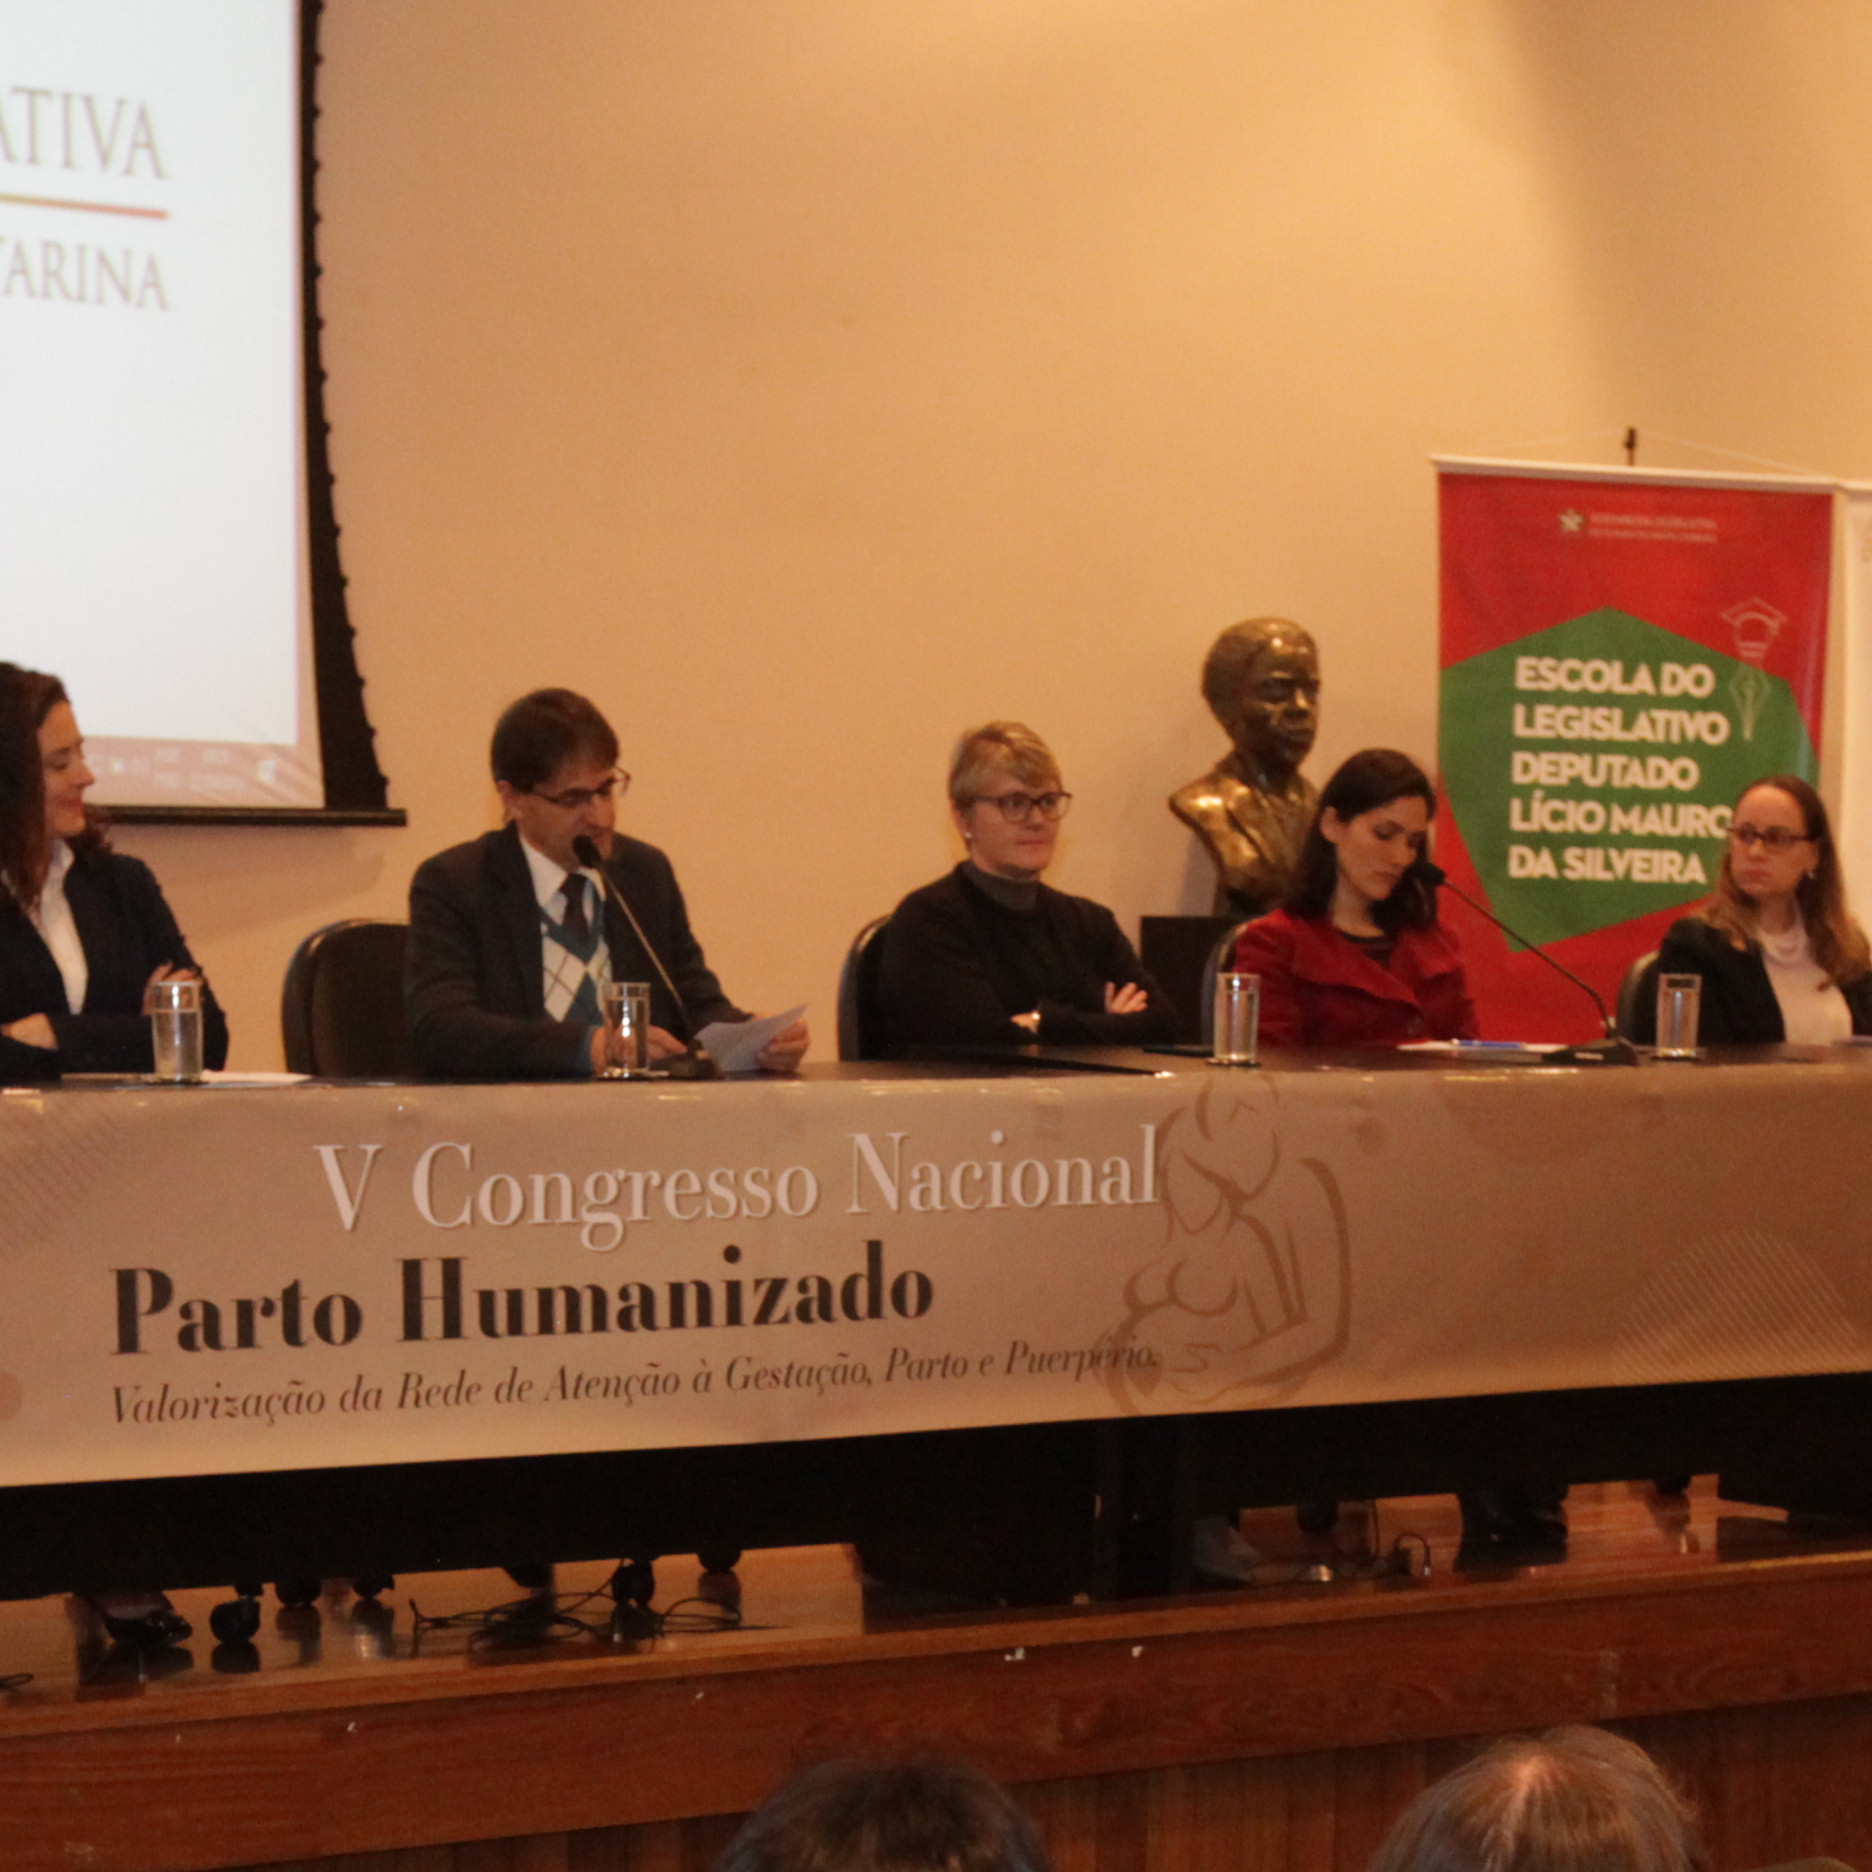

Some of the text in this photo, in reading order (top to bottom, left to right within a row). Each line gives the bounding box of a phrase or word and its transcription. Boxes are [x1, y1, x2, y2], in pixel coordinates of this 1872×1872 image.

[1514, 655, 1717, 699] ESCOLA DO
[1512, 702, 1732, 747] LEGISLATIVO
[1511, 750, 1701, 792] DEPUTADO
[1509, 788, 1608, 835] LÍCIO
[1507, 844, 1708, 885] DA SILVEIRA
[312, 1123, 1161, 1252] V Congresso Nacional
[108, 1239, 934, 1355] Parto Humanizado
[112, 1379, 326, 1427] Valorização
[339, 1373, 384, 1414] da
[397, 1368, 483, 1411] Rede
[494, 1365, 534, 1404] de
[541, 1362, 681, 1407] Atenção
[691, 1358, 714, 1395] à
[725, 1351, 874, 1398] Gestação,
[884, 1346, 970, 1384] Parto
[978, 1355, 995, 1377] e
